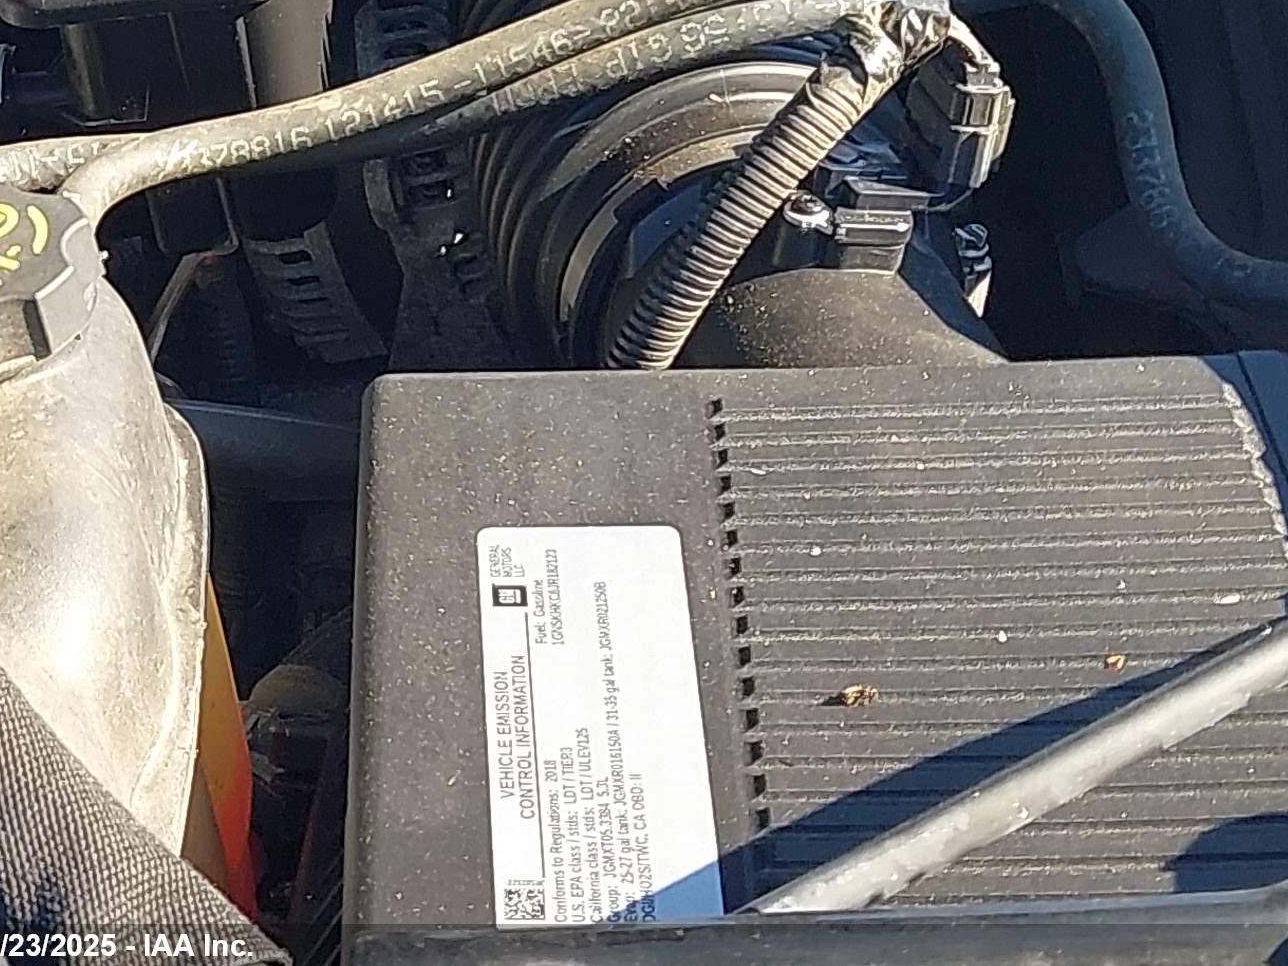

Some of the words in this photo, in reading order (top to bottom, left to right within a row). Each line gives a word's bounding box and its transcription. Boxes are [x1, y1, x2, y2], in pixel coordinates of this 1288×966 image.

[489, 544, 500, 576] GENERAL
[501, 547, 512, 576] MOTORS
[514, 564, 525, 577] LLC
[532, 579, 545, 616] Gasoline
[534, 622, 547, 643] Fuel:
[602, 679, 620, 693] gal
[494, 671, 511, 734] EMISSION
[511, 655, 530, 746] INFORMATION
[604, 694, 618, 720] 31-35
[575, 727, 592, 771] ULEV125
[498, 739, 515, 798] VEHICLE
[544, 760, 558, 781] 2018
[517, 751, 535, 818] CONTROL
[562, 784, 577, 803] LDT
[580, 780, 594, 799] LDT
[596, 776, 610, 796] 5.3L
[630, 782, 645, 810] OBD:
[547, 789, 565, 852] Regulations:
[564, 811, 579, 835] stds:
[581, 807, 596, 831] stds:
[632, 814, 647, 830] CA
[568, 845, 582, 872] class
[585, 841, 598, 868] class
[617, 838, 634, 853] gal
[552, 857, 563, 866] to
[618, 856, 634, 883] 25-27
[552, 870, 567, 922] Conforms
[570, 876, 584, 897] EPA
[588, 871, 603, 922] California
[572, 900, 585, 922] U.S.
[607, 885, 621, 922] Group:
[624, 892, 640, 921] Evap:
